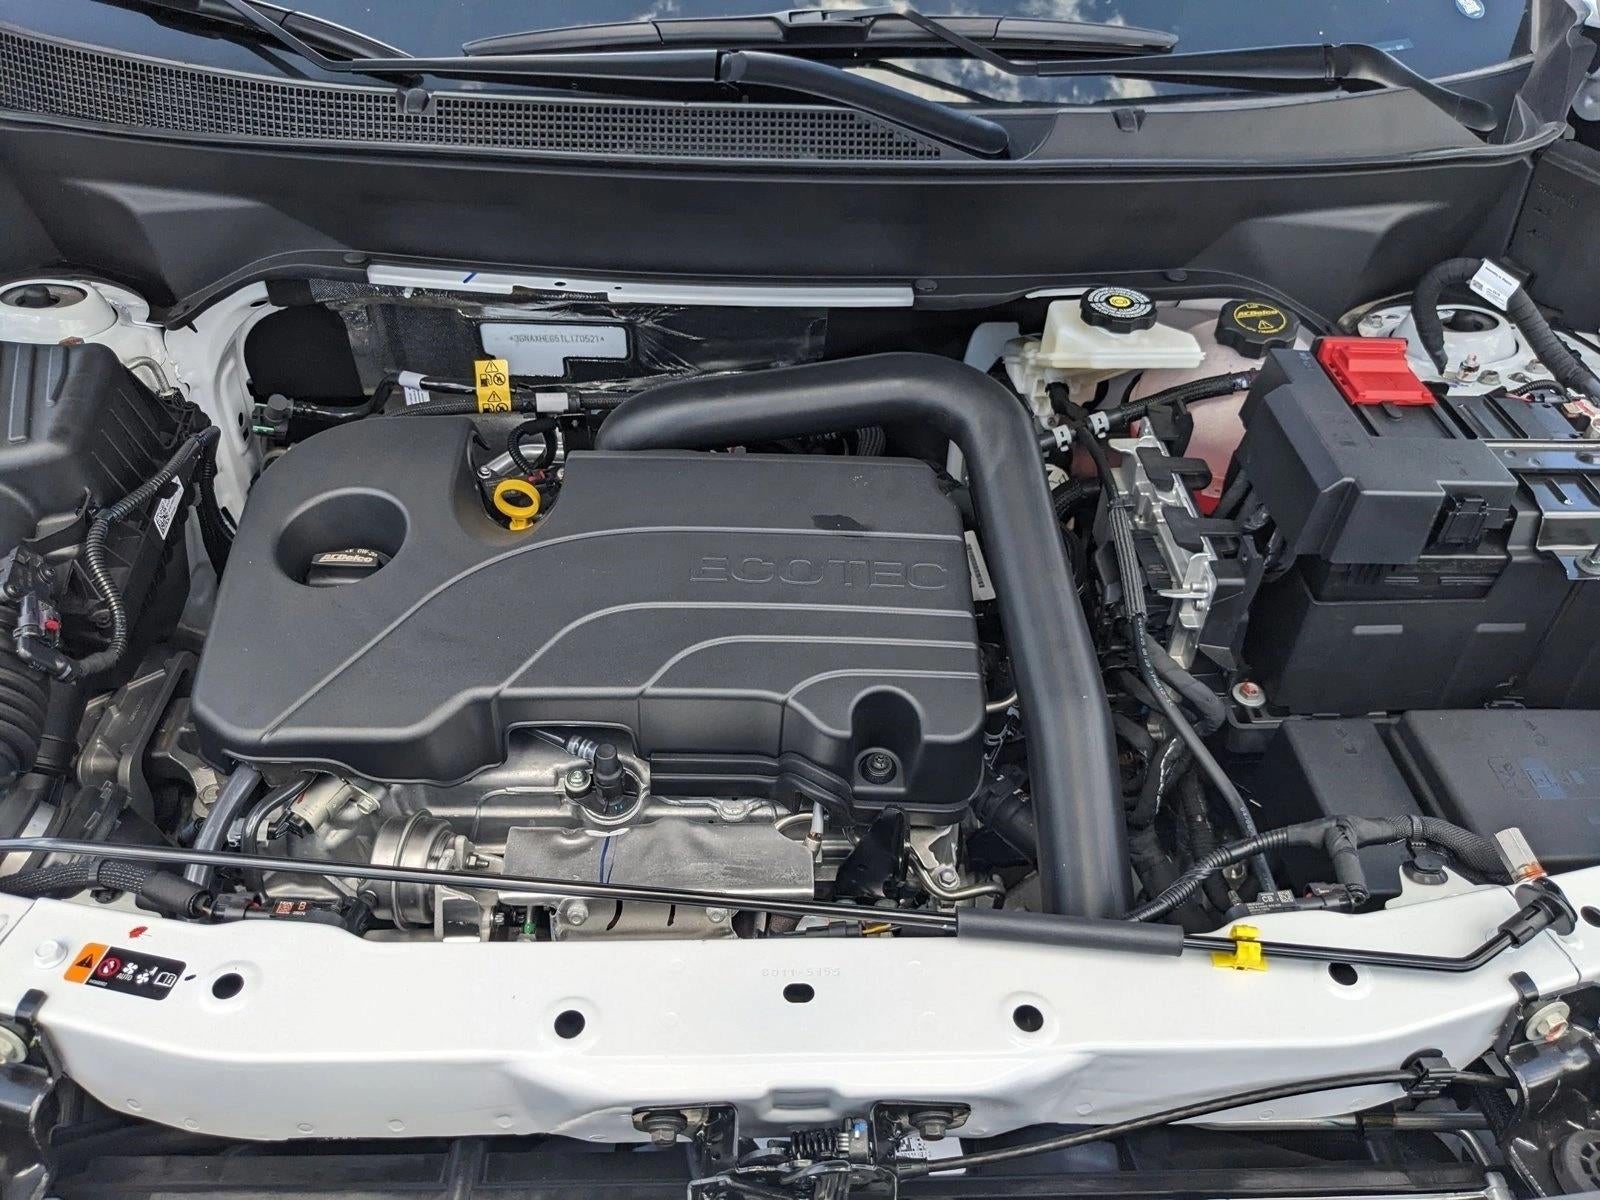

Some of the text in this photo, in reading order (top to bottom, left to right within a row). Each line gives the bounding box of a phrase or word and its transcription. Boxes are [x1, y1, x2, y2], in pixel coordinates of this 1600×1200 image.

[319, 553, 374, 563] ACDelco
[689, 556, 948, 590] ECOTEC
[1261, 895, 1275, 903] CB
[115, 972, 133, 981] AUTO
